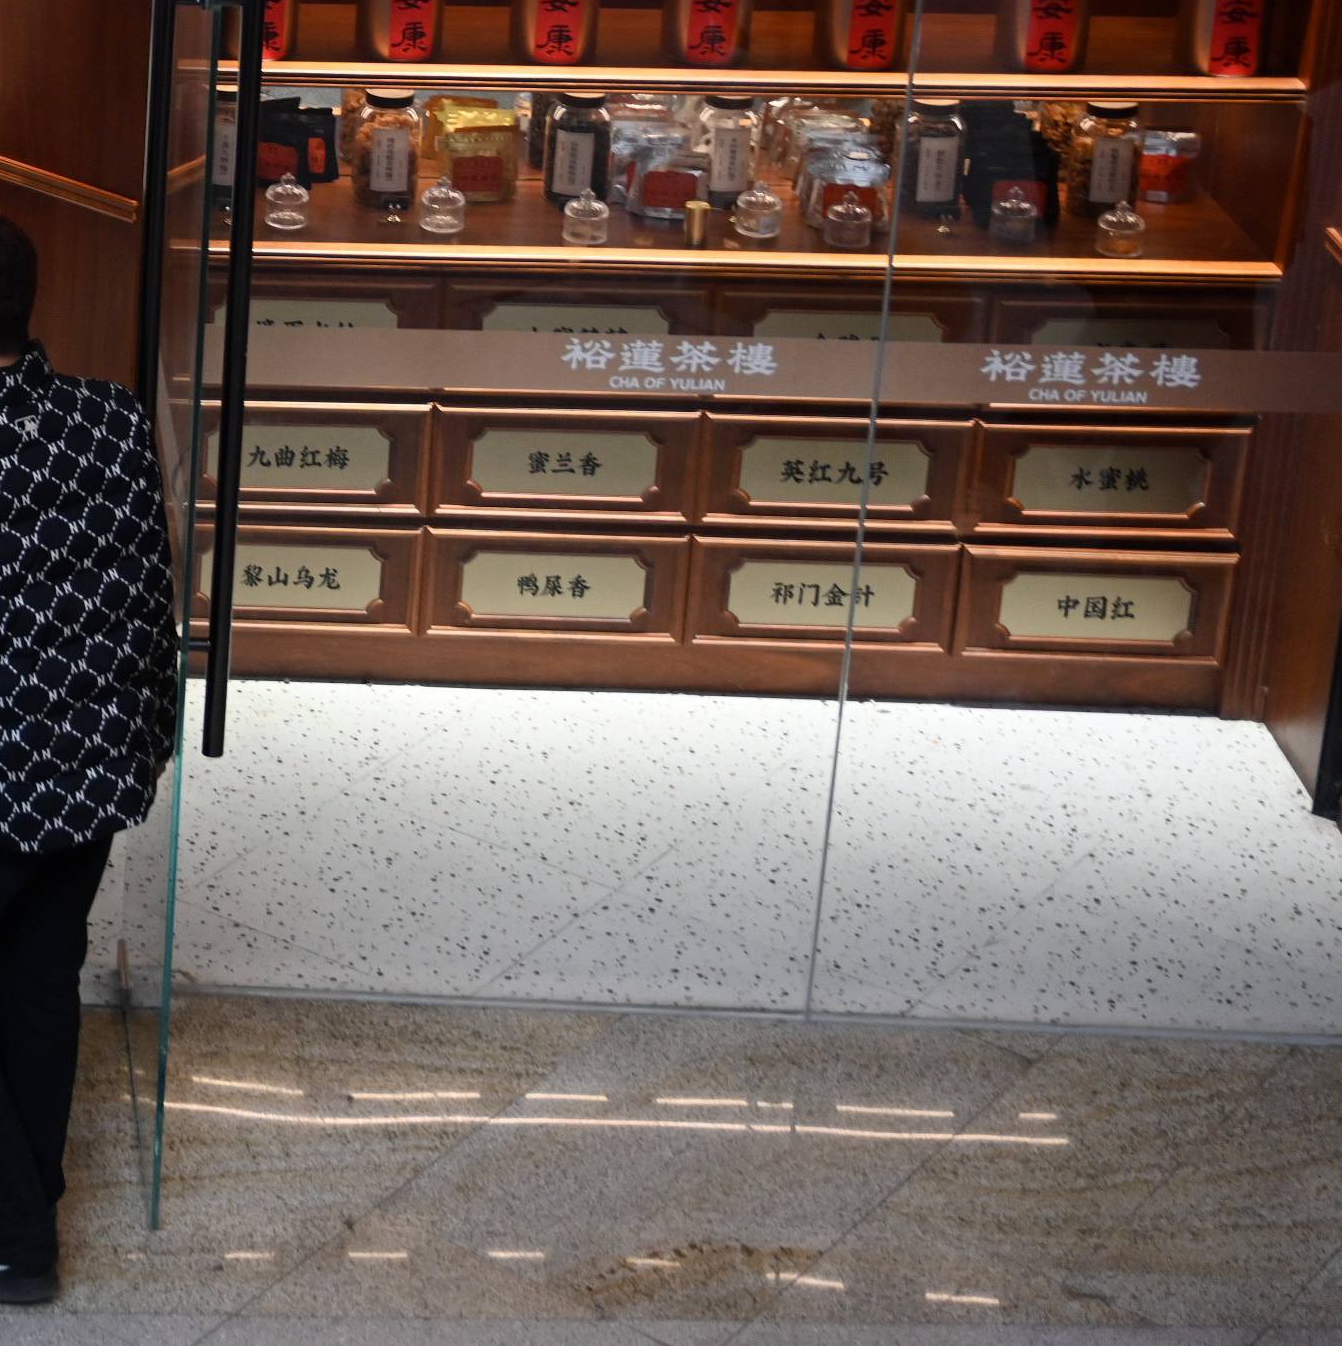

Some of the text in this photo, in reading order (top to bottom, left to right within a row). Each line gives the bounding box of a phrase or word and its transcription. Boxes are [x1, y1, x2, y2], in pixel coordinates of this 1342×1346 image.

[561, 337, 778, 376] 裕蓮茶樓
[980, 349, 1202, 389] 裕蓮茶樓
[609, 376, 726, 391] CHA OF YULIAN
[1029, 388, 1147, 404] CHA OF YULIAN
[248, 445, 350, 471] 九曲红梅
[527, 451, 602, 477] 蜜兰香
[1056, 594, 1135, 622] 中国红
